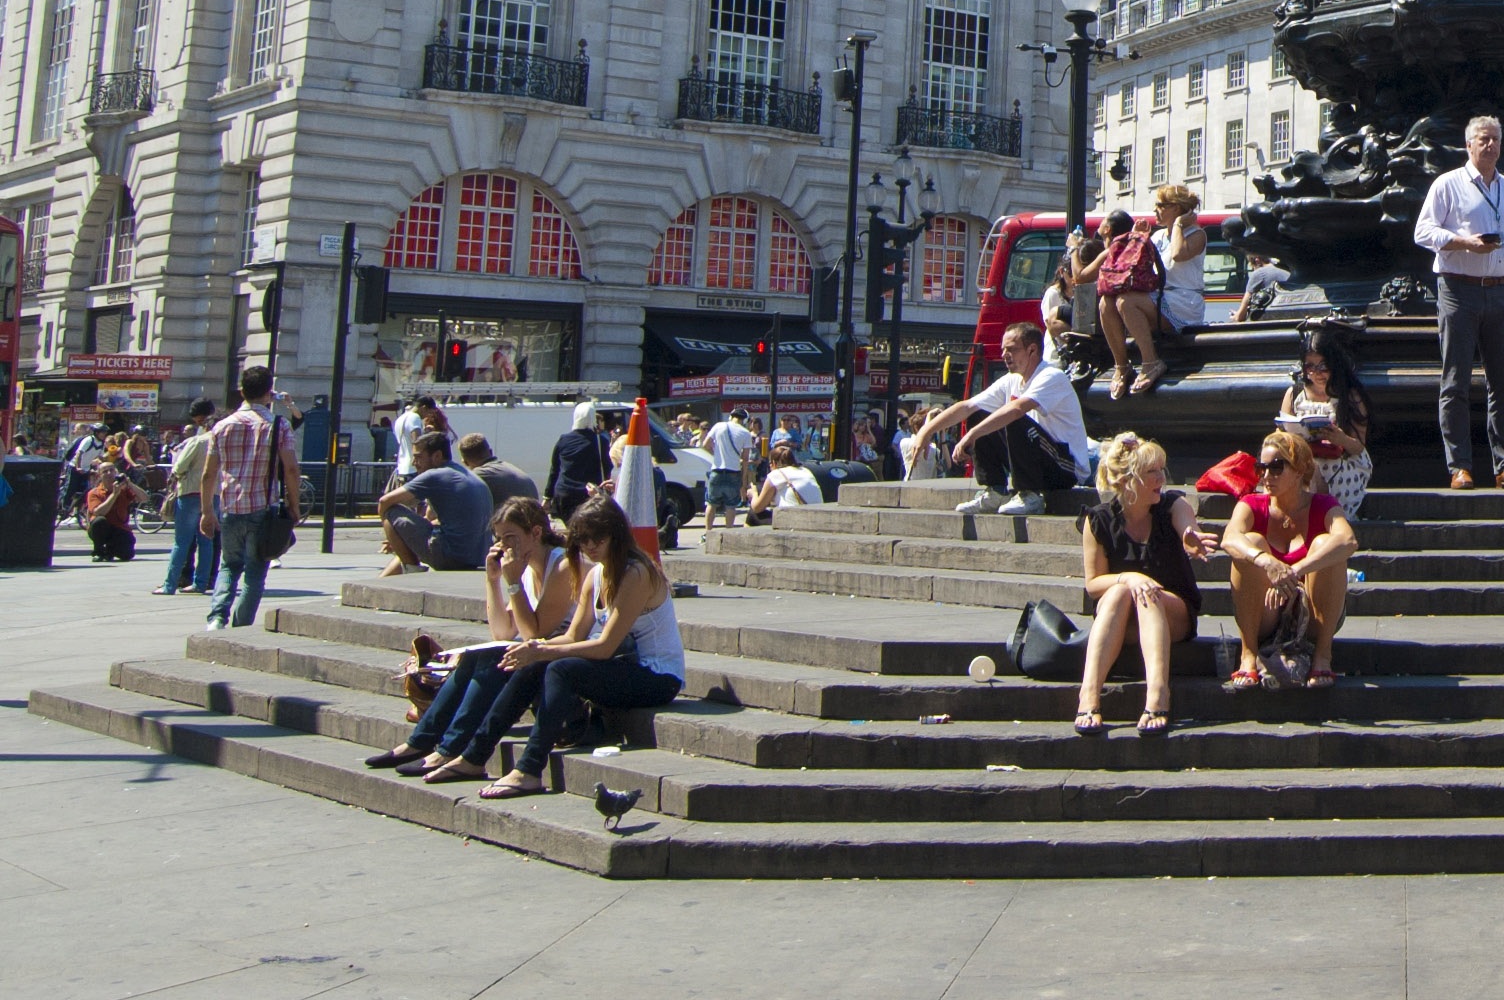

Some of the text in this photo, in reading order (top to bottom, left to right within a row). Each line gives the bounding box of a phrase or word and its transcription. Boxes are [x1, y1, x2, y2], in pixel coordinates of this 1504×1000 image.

[700, 297, 763, 309] THE STING
[737, 343, 811, 353] SNG
[96, 357, 139, 368] TICKETS
[142, 358, 171, 369] HERE
[900, 376, 938, 386] STING
